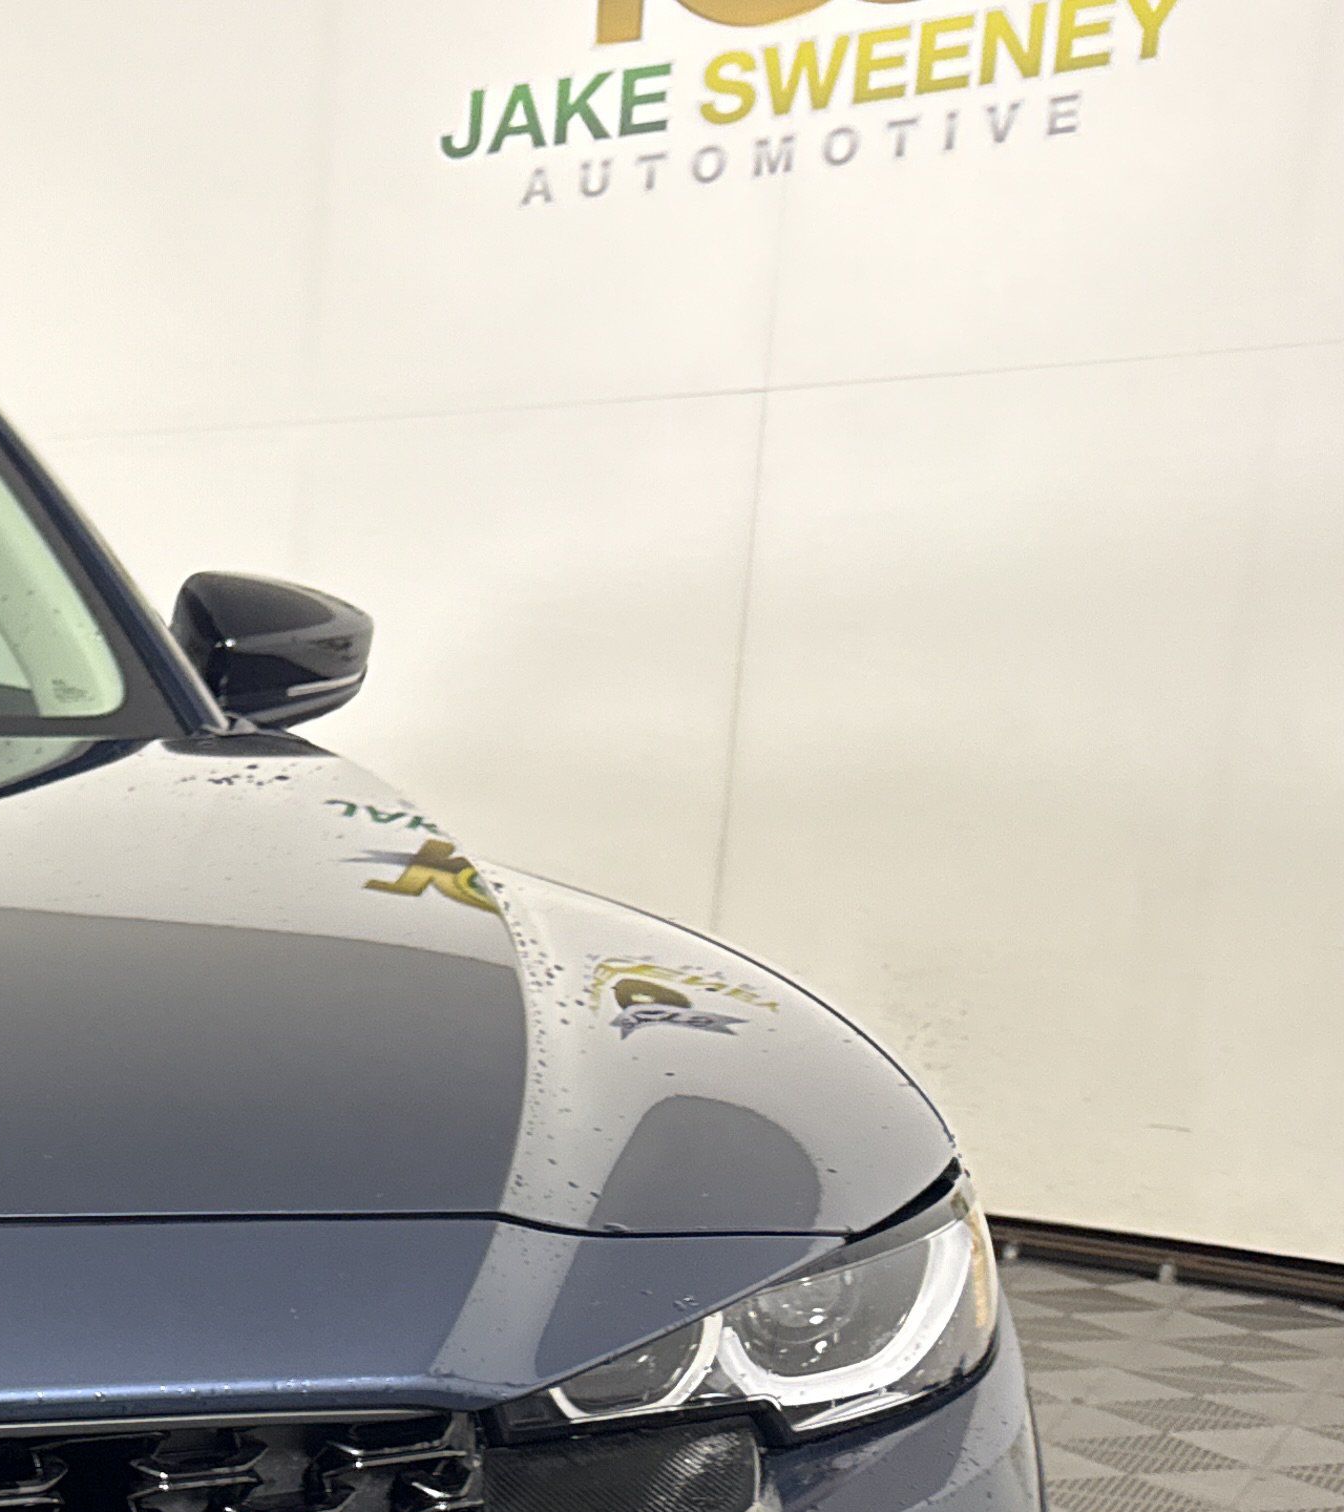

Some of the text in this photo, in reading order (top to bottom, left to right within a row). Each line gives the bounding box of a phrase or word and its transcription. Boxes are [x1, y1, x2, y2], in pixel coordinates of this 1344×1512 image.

[440, 62, 673, 160] JAKE
[698, 0, 1179, 126] SWEENEY
[519, 93, 1081, 207] AUTOMOTIVE
